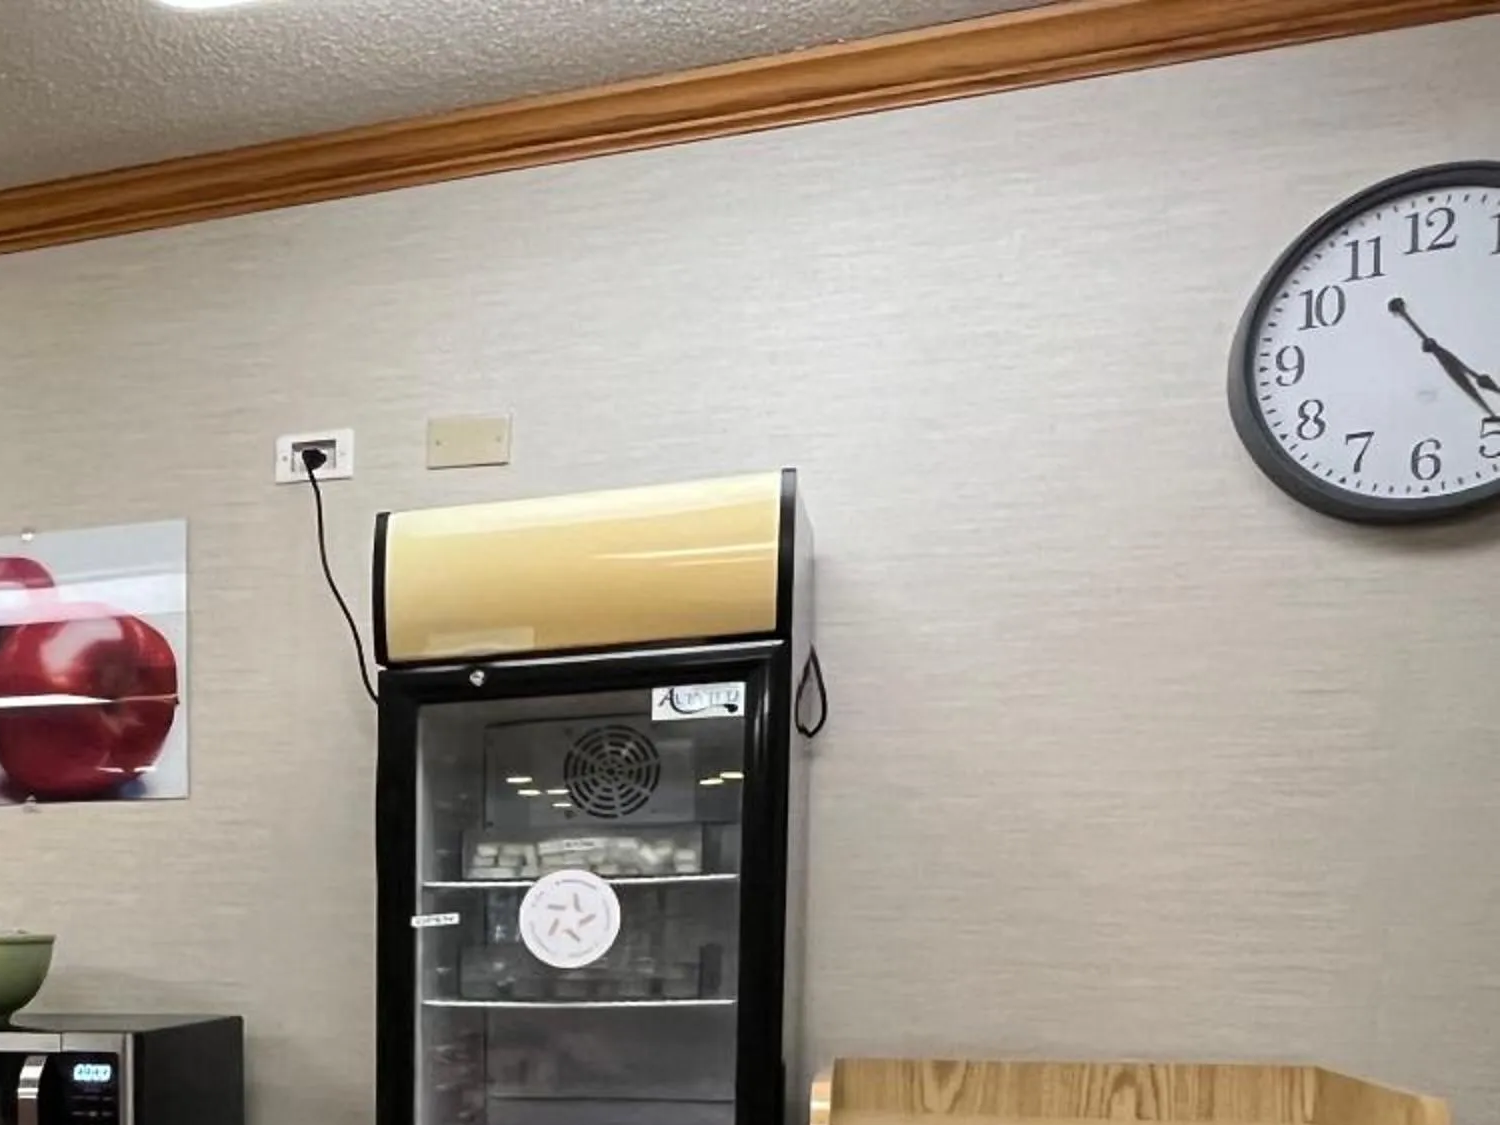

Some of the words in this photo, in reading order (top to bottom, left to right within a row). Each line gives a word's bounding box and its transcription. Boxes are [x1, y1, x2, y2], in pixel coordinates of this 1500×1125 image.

[1403, 207, 1457, 256] 12
[1345, 236, 1386, 282] 11
[1298, 285, 1345, 331] 10
[1275, 345, 1305, 387] 9
[1297, 399, 1326, 441] 8
[1345, 431, 1375, 474] 7
[1410, 439, 1442, 481] 6
